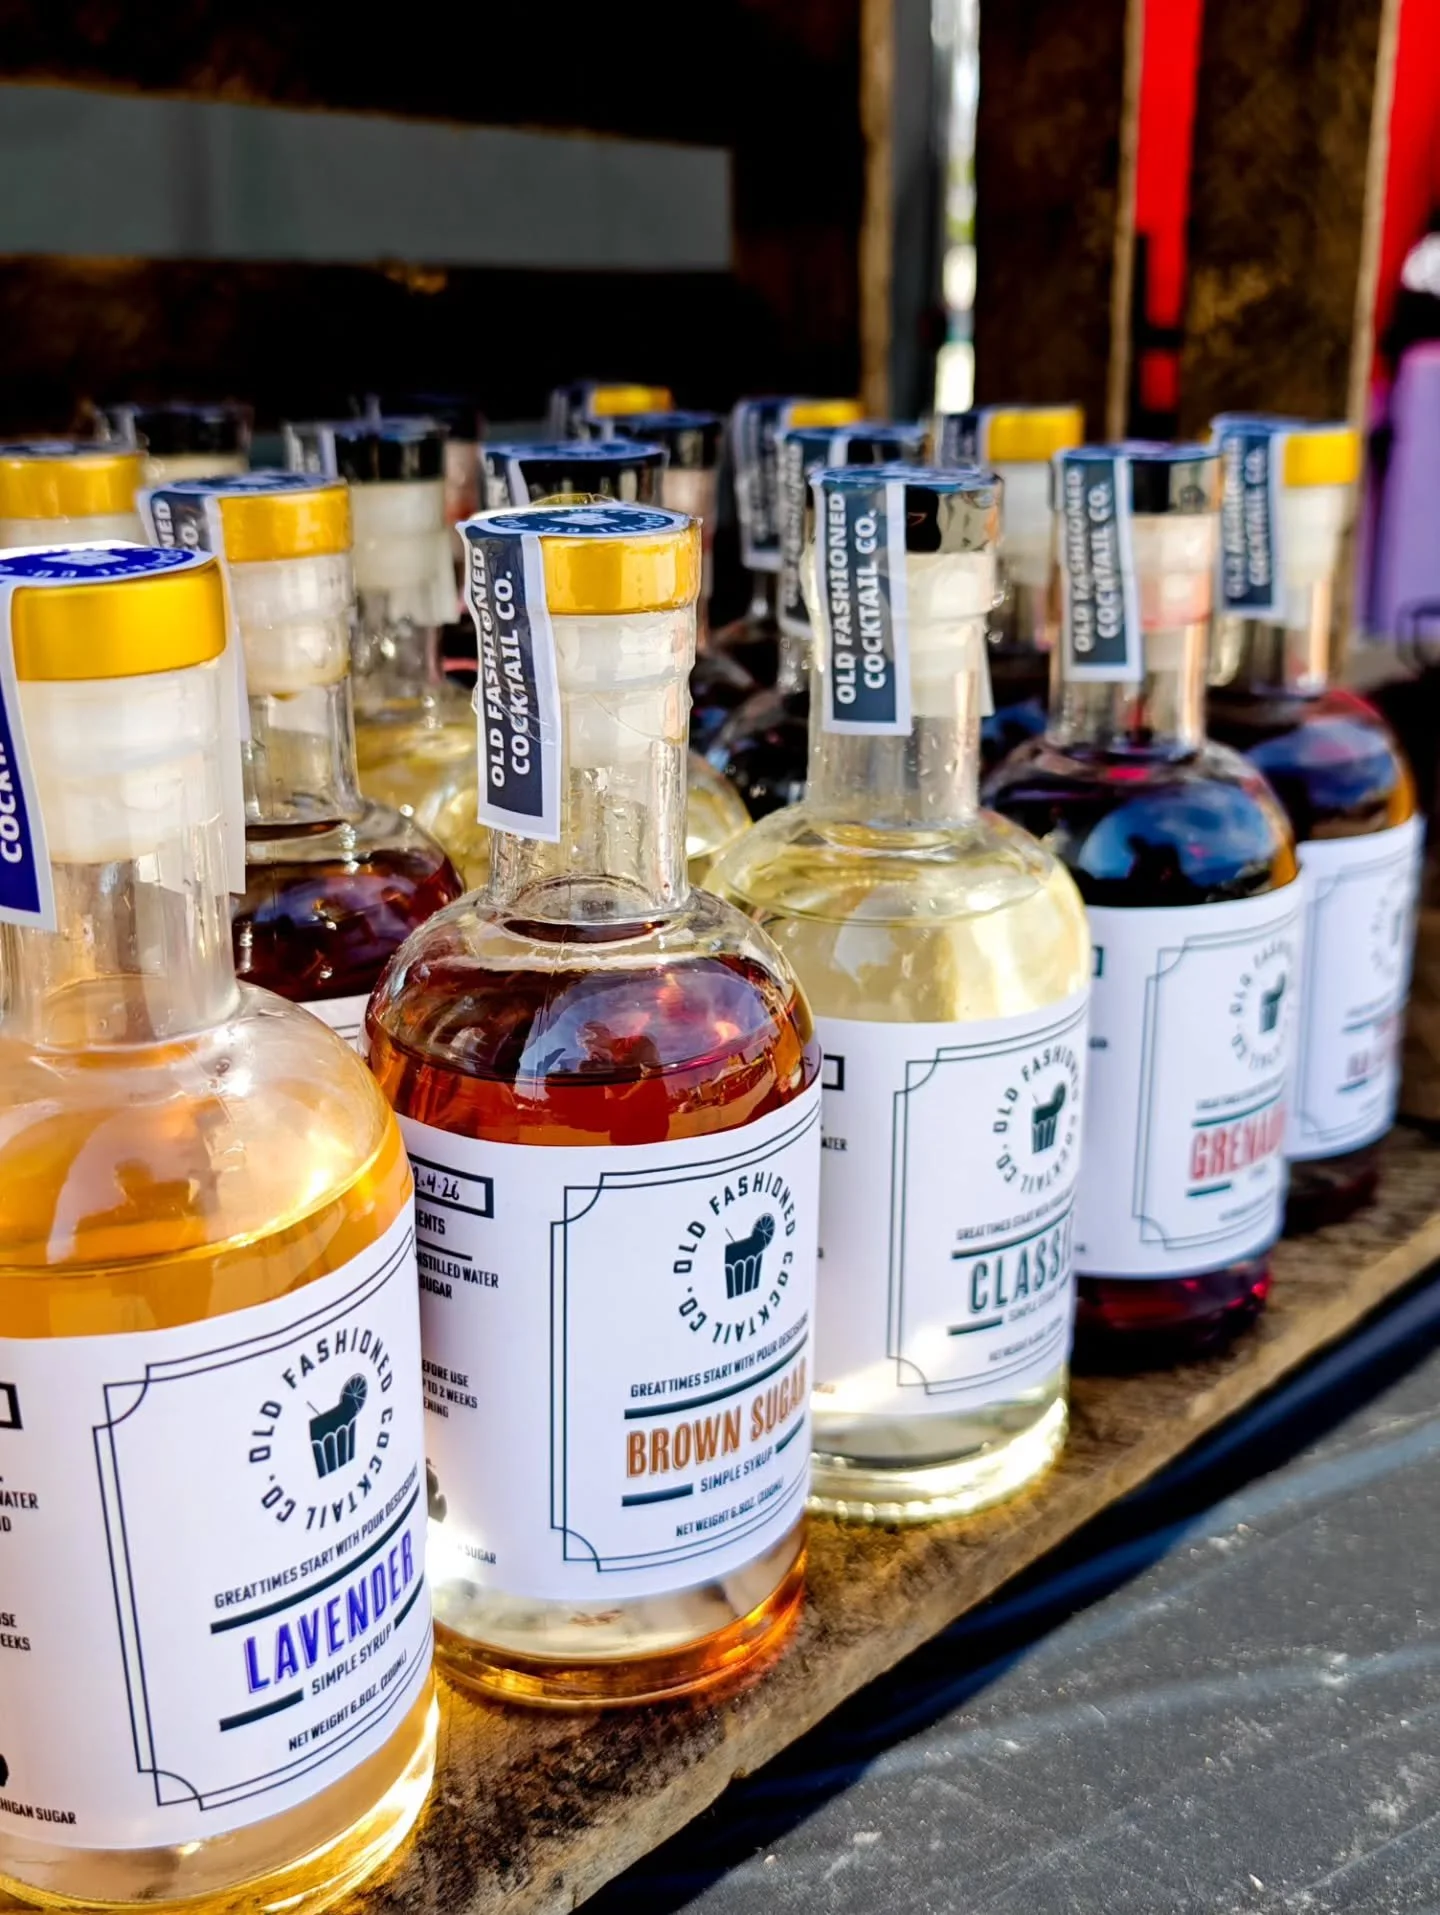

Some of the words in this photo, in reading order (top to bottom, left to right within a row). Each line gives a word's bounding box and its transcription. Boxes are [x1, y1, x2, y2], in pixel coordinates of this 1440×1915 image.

[1088, 481, 1112, 522] CO.
[855, 509, 877, 554] CO.
[1066, 468, 1090, 600] FASHIONED
[829, 493, 853, 646] FASHIONED
[1091, 523, 1119, 638] COCKTAIL
[495, 571, 515, 621] CO.
[472, 547, 503, 721] FASHIONED
[857, 560, 886, 689] COCKTAIL
[1073, 602, 1094, 652] OLD
[500, 629, 531, 775] COCKTAIL
[835, 652, 857, 705] OLD
[490, 728, 505, 787] OLD
[993, 1087, 1019, 1134] OLD
[821, 1136, 848, 1151] ATER
[996, 1143, 1017, 1183] CO.
[709, 1171, 796, 1237] FASHIONED
[673, 1220, 706, 1274] OLD
[462, 1266, 499, 1288] WATER
[712, 1250, 793, 1344] COCKTAIL
[679, 1286, 707, 1332] CO.
[282, 1327, 393, 1393] FASHIONED
[422, 1359, 448, 1381] EFORE
[450, 1370, 469, 1388] USE
[631, 1382, 668, 1398] GREAT
[669, 1373, 702, 1393] TIMES
[703, 1363, 733, 1384] START
[734, 1352, 755, 1374] WITH
[756, 1339, 777, 1362] POUR
[423, 1396, 449, 1418] ENING
[427, 1379, 438, 1395] TO
[440, 1385, 445, 1398] 2
[446, 1388, 478, 1409] WEEKS
[249, 1400, 283, 1463] OLD
[627, 1404, 741, 1478] BROWN
[306, 1407, 393, 1530] COCKTAIL
[700, 1464, 741, 1493] SIMPLE
[743, 1447, 773, 1475] SYRUP
[260, 1473, 297, 1523] CO.
[676, 1523, 694, 1537] NET
[695, 1508, 730, 1532] WEIGHT
[215, 1583, 259, 1609] GREAT
[258, 1567, 298, 1593] TIMES
[300, 1547, 335, 1577] START
[336, 1530, 360, 1557] WITH
[362, 1508, 385, 1539] POUR
[464, 1544, 497, 1565] SUGAR
[0, 1611, 17, 1628] SE
[244, 1528, 414, 1694] LAVENDER
[0, 1632, 31, 1651] EEKS
[312, 1657, 357, 1695] SIMPLE
[359, 1623, 392, 1664] SYRUP
[288, 1732, 309, 1752] NET
[311, 1705, 350, 1740] WEIGHT
[36, 1807, 77, 1825] SUGAR
